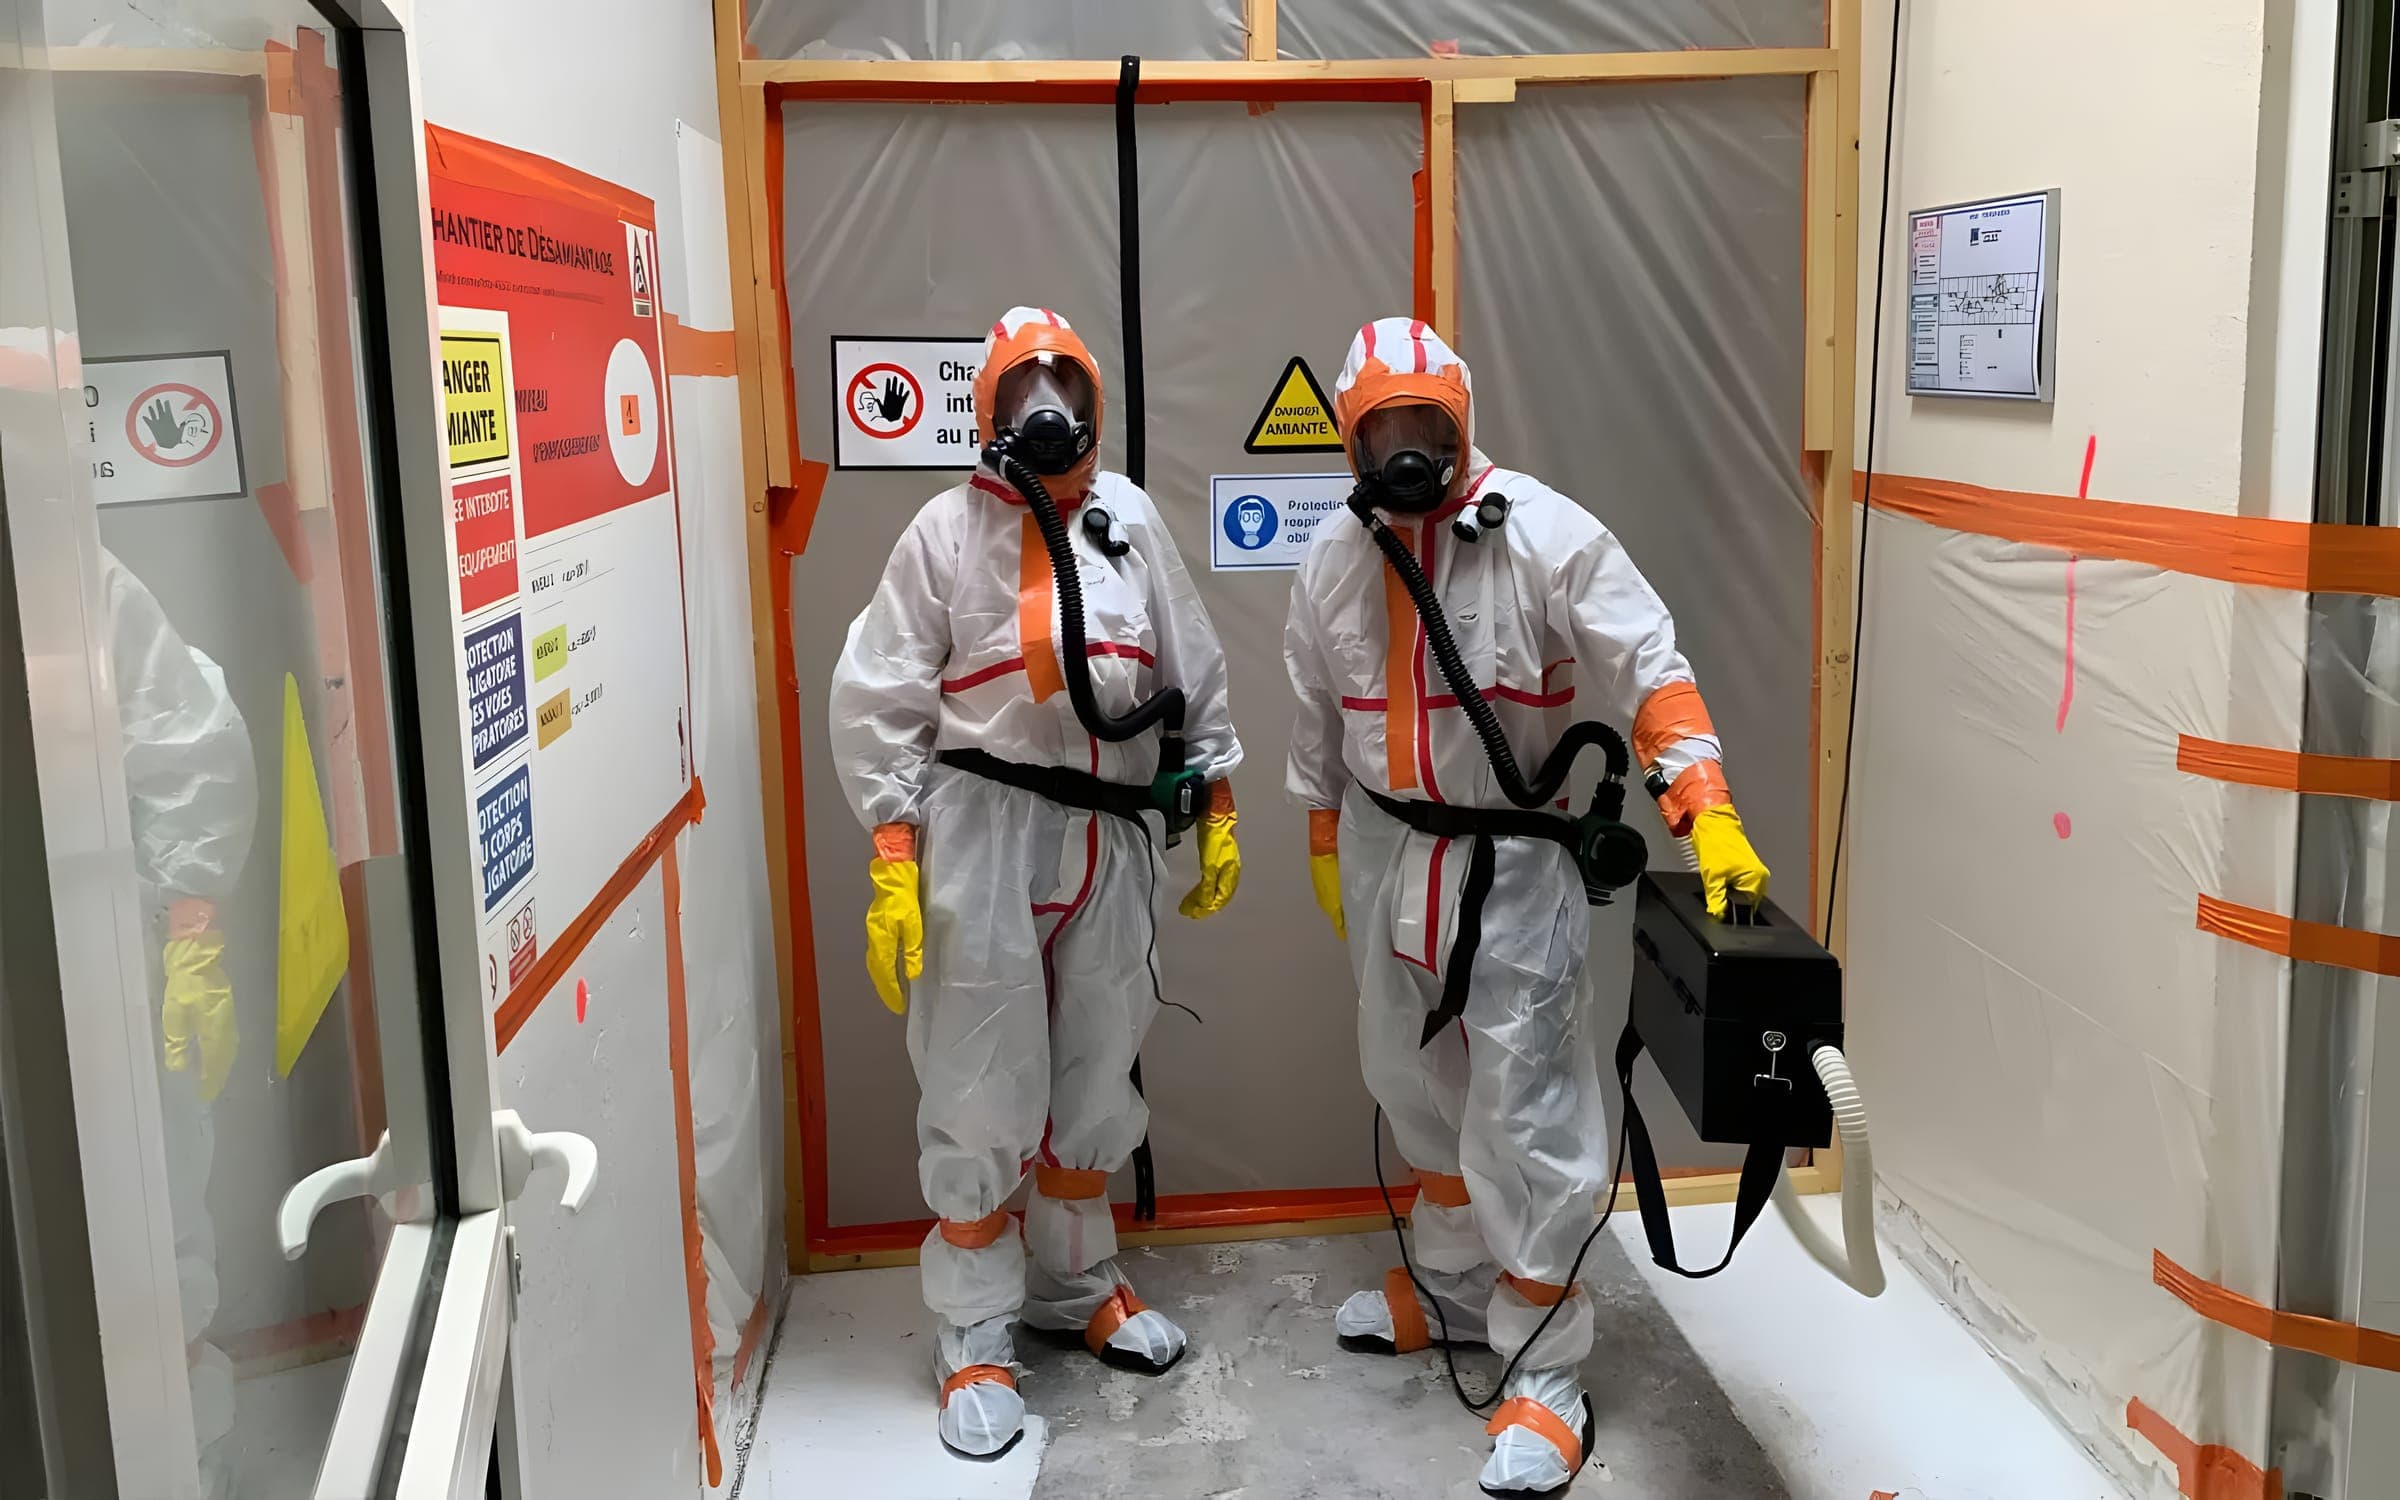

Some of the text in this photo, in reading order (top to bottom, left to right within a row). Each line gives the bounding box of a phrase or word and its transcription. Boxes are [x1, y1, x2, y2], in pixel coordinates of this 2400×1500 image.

[506, 226, 527, 258] DE
[442, 360, 491, 394] ANGER
[937, 428, 962, 444] au
[1265, 421, 1328, 435] AMIANTE
